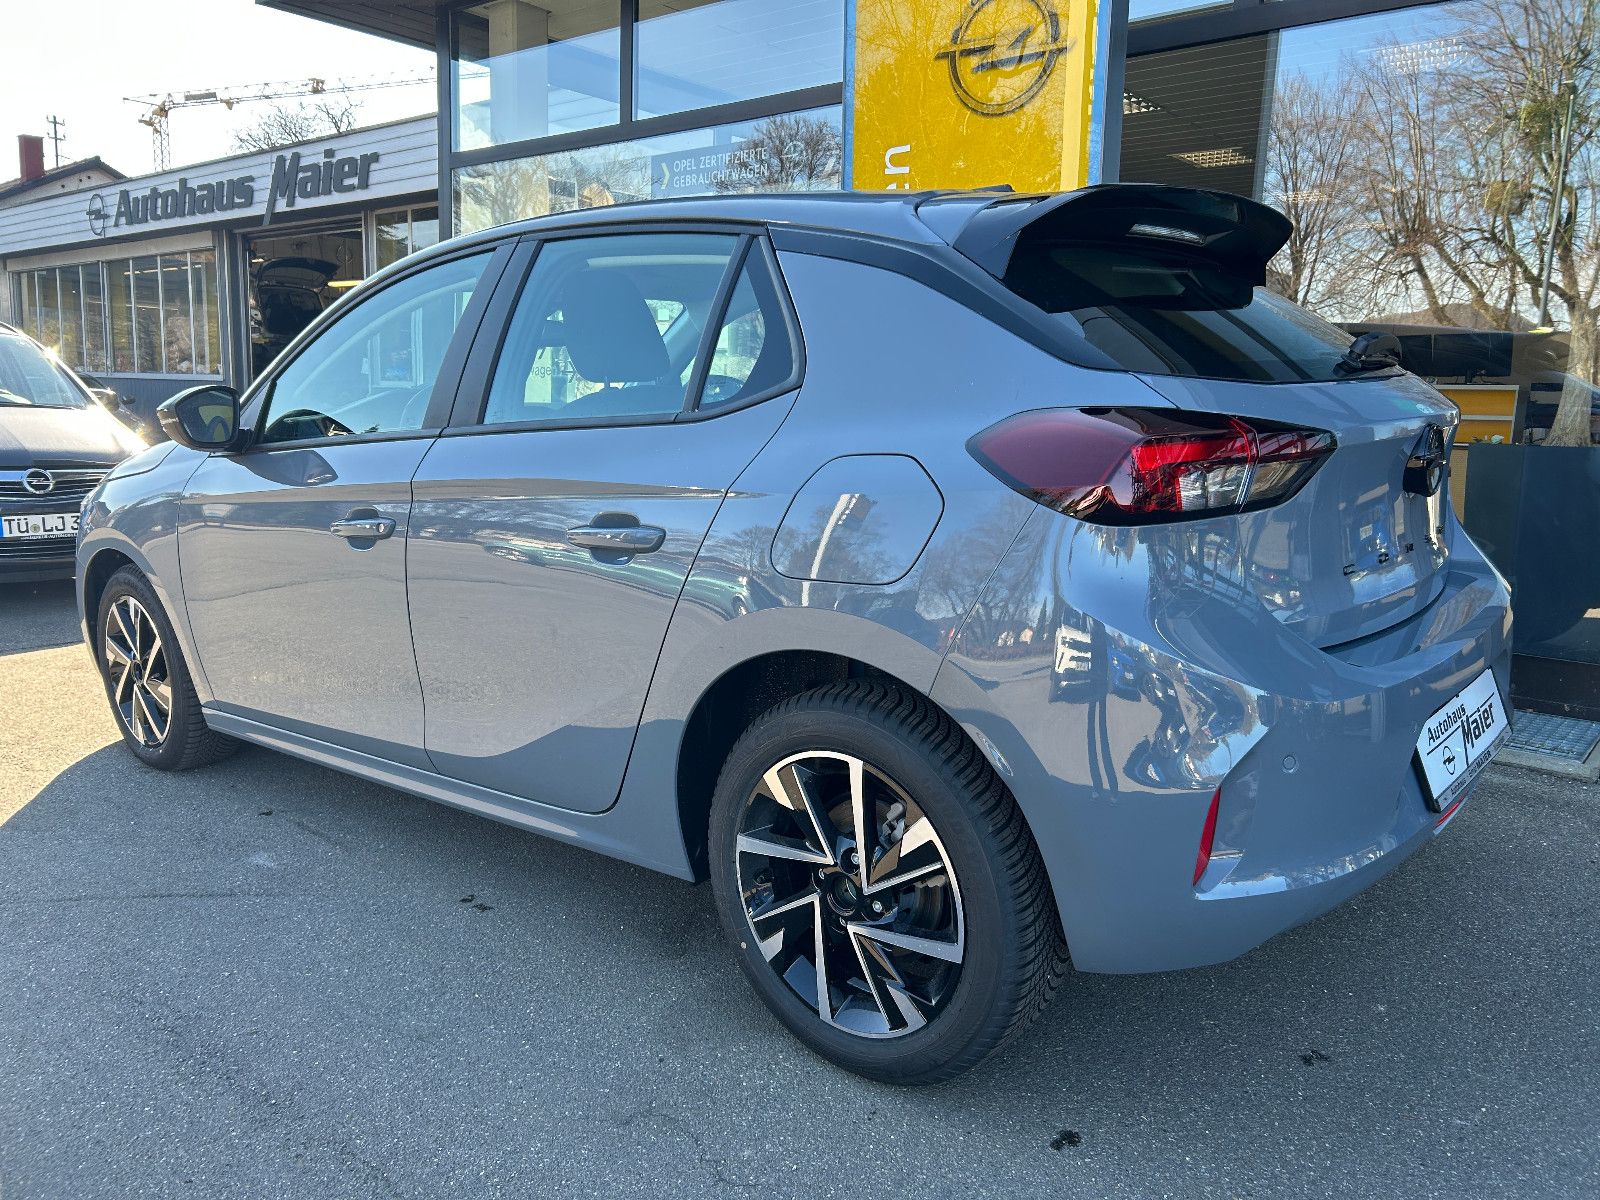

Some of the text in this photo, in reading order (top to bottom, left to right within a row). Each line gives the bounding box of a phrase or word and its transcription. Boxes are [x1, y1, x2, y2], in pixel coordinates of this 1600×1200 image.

[673, 147, 768, 173] OPEL ZERTIFIZIERTE
[673, 163, 768, 188] GEBRAUCHTWAGEN
[113, 148, 379, 228] Autohaus Maier
[4, 517, 30, 534] TÜ
[42, 516, 66, 532] LJ
[1427, 703, 1467, 747] Autohaus
[1460, 702, 1494, 767] Maier
